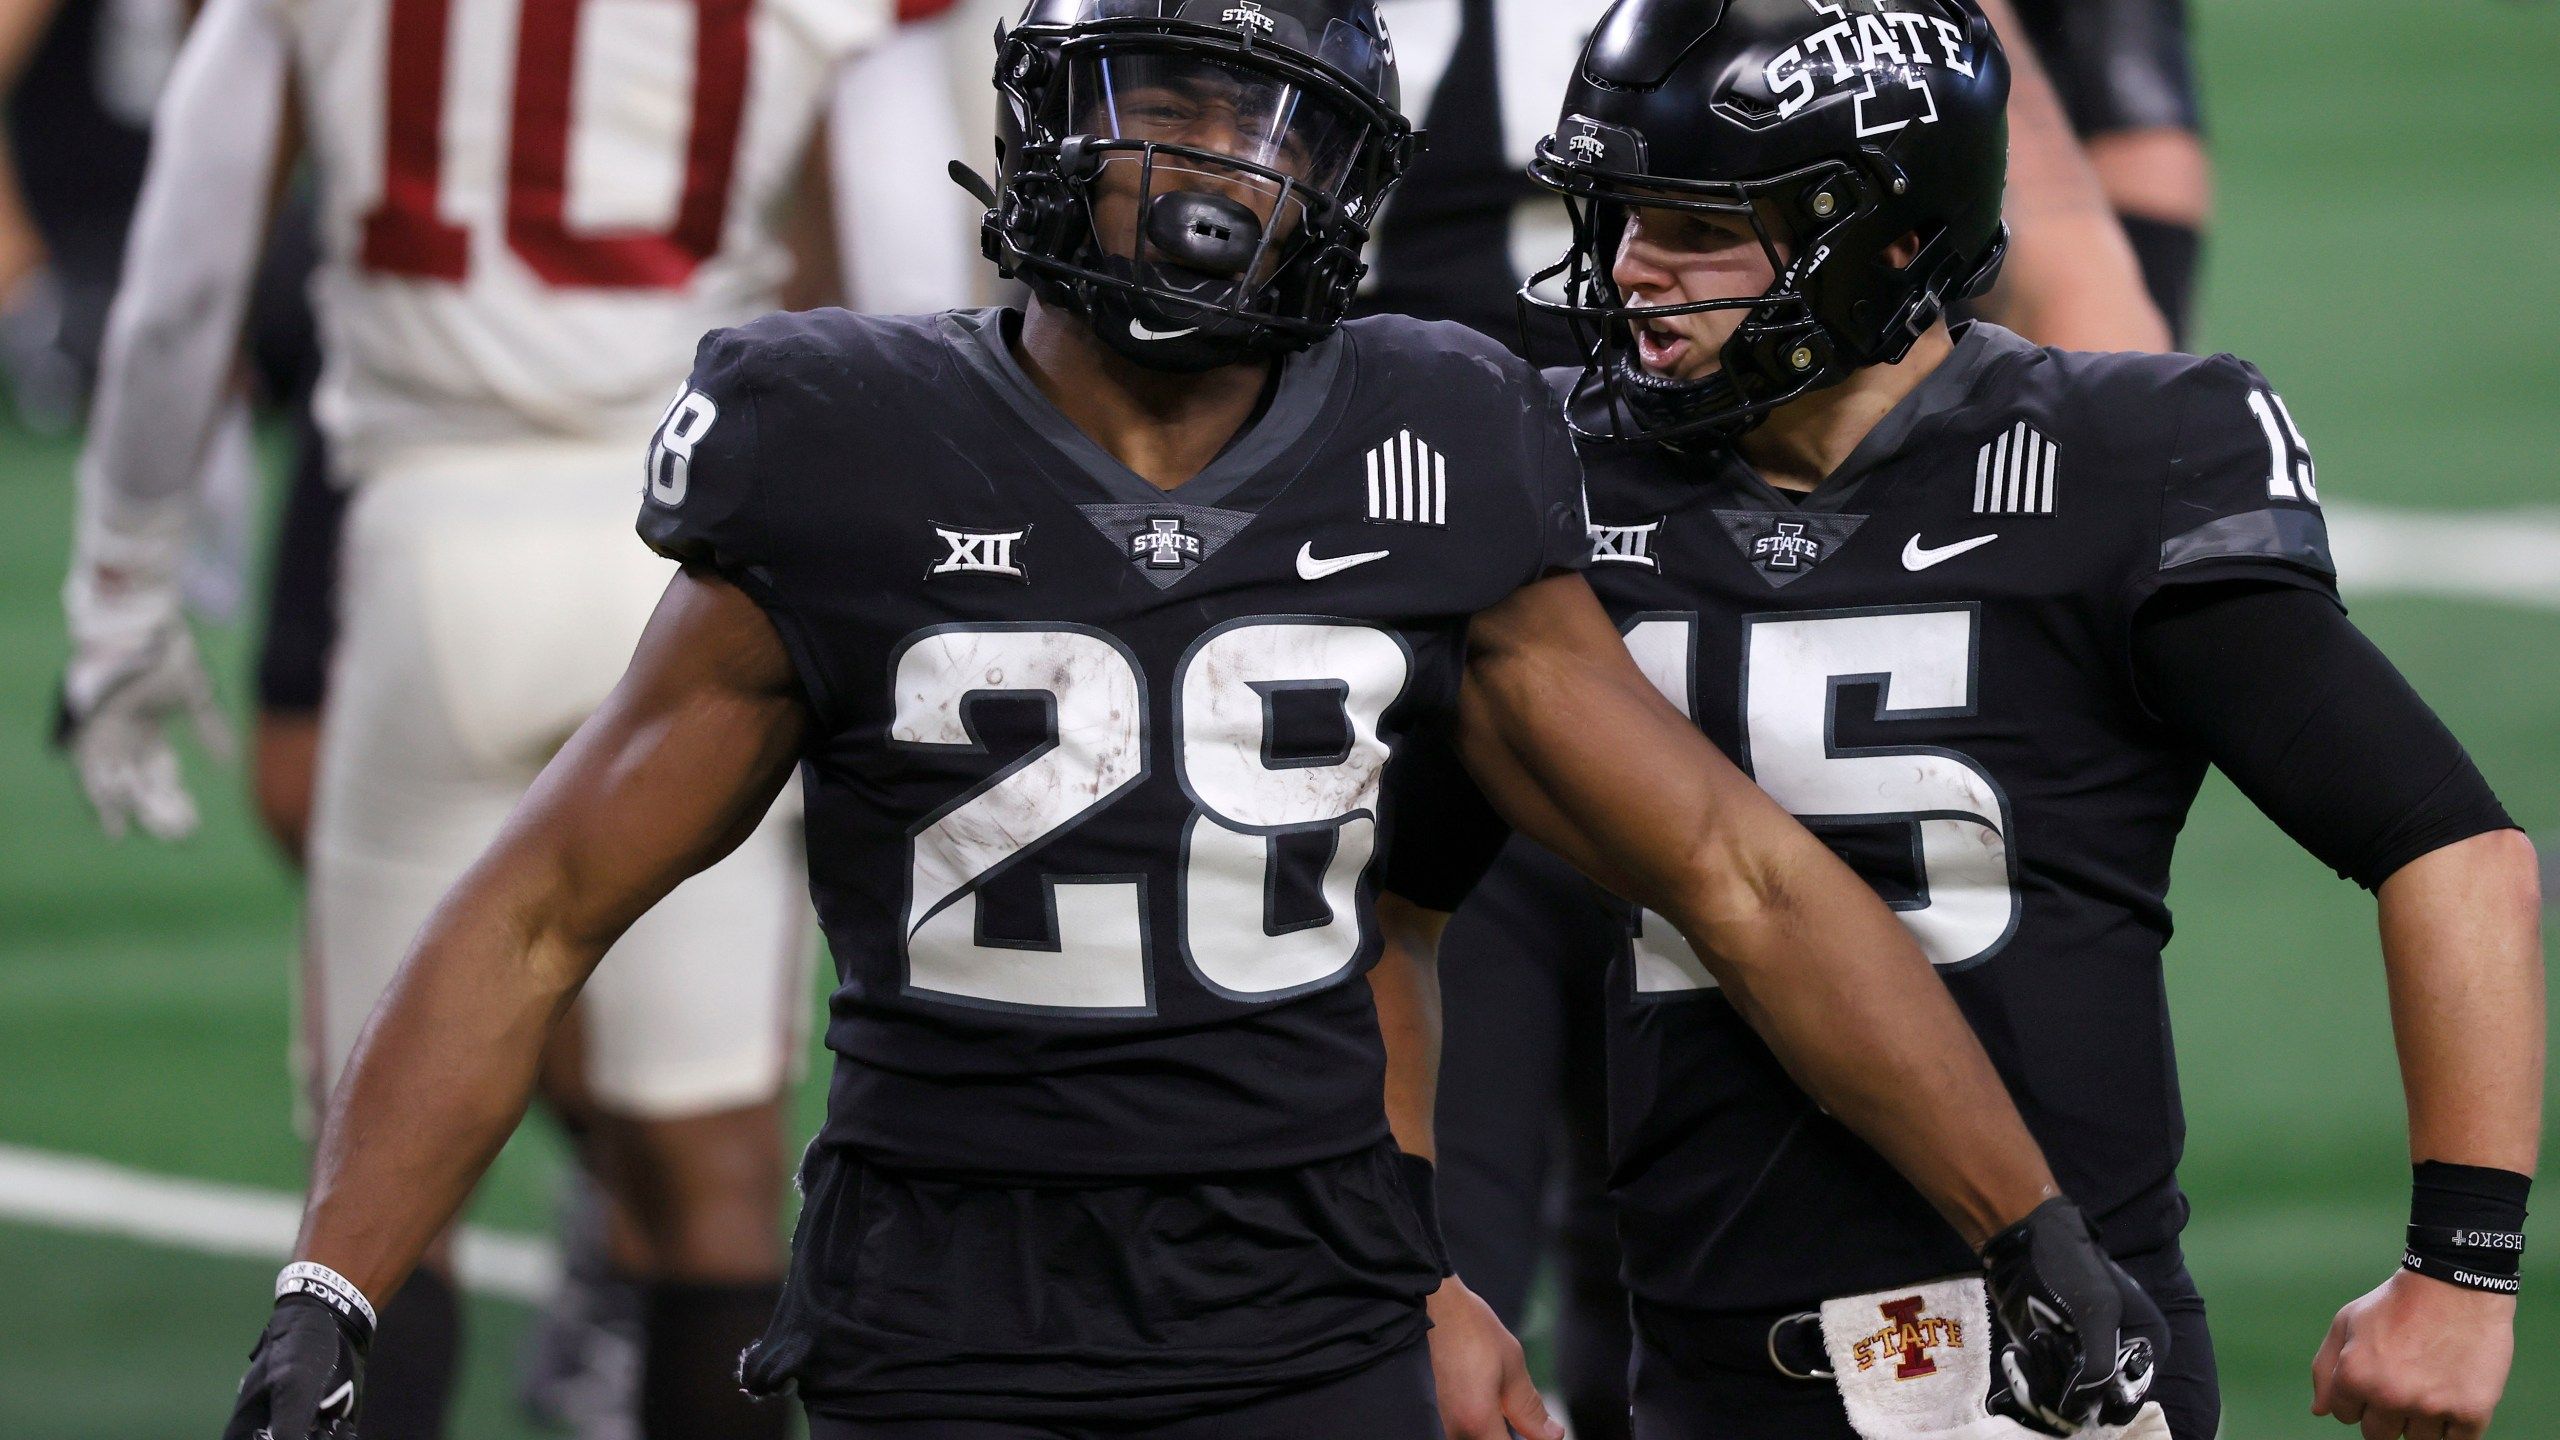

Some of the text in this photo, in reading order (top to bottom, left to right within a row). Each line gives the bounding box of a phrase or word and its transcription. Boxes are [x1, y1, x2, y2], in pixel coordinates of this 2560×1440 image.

[1221, 8, 1275, 33] STATE
[1764, 11, 1976, 120] STATE
[362, 0, 752, 290] 10
[1568, 134, 1605, 159] STATE
[933, 527, 1024, 577] XII
[1133, 532, 1200, 555] STATE
[1755, 536, 1819, 558] STATE
[886, 615, 1412, 1015] 28
[304, 1280, 352, 1316] BLACK
[1852, 1317, 1964, 1373] STATE
